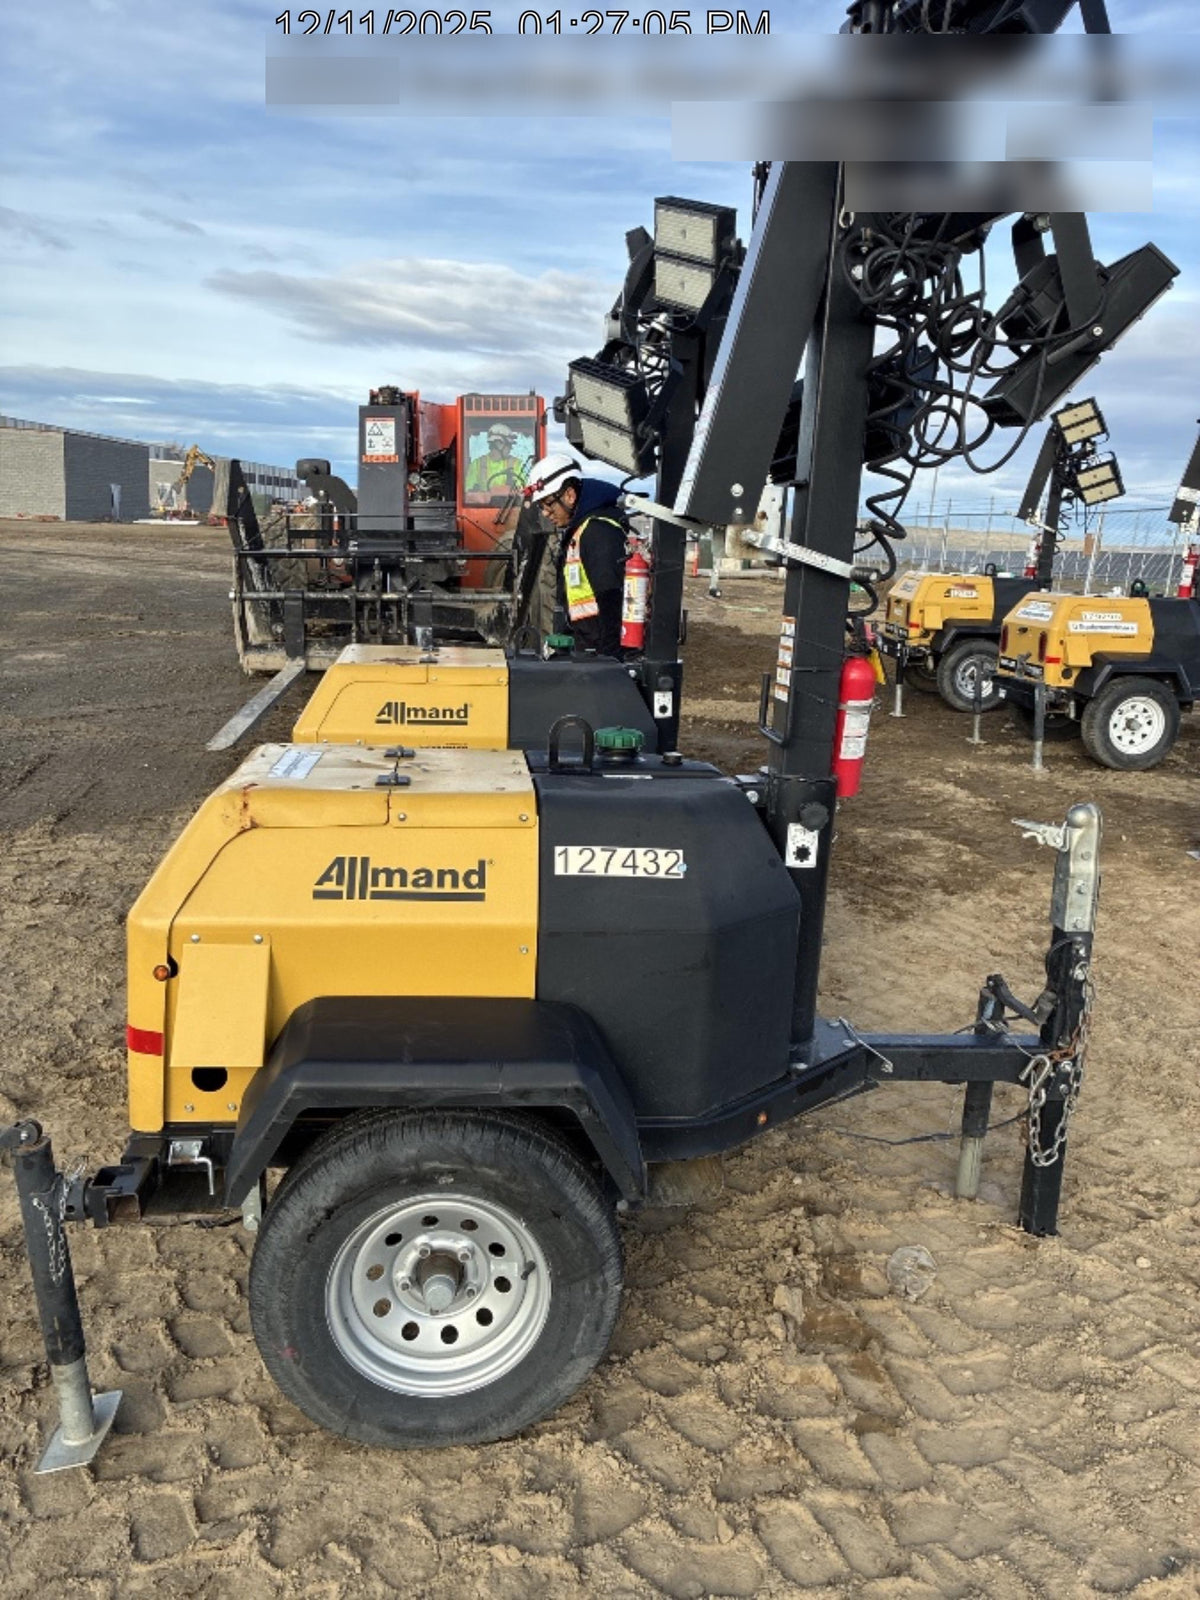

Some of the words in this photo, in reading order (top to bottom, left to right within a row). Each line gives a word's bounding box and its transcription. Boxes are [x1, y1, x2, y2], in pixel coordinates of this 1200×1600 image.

[375, 702, 468, 726] Allmand
[557, 846, 682, 877] 127432
[313, 856, 487, 901] Allmand
